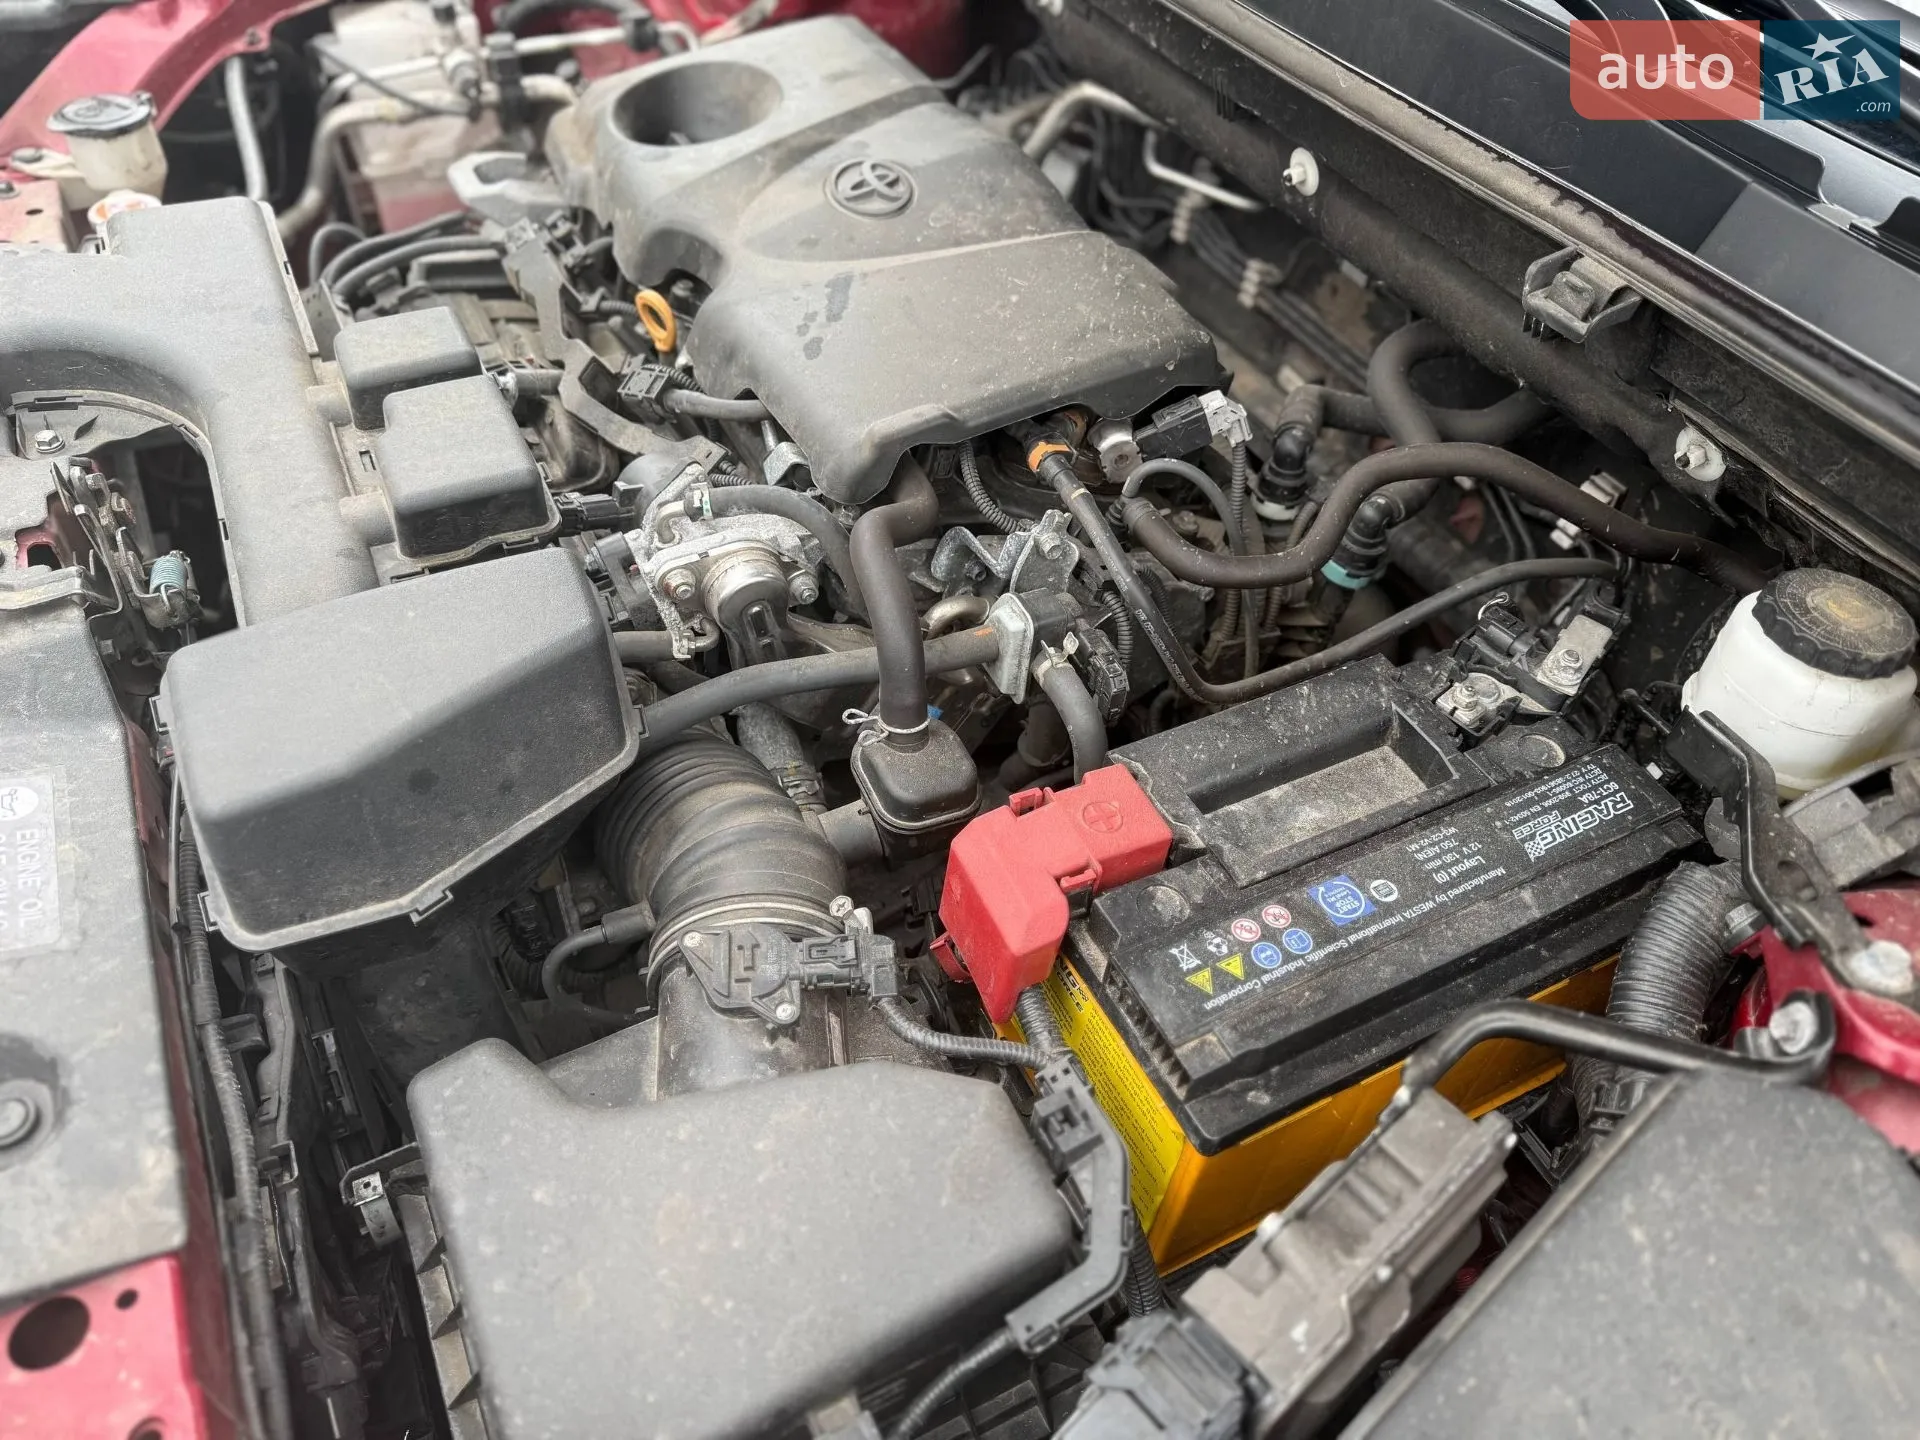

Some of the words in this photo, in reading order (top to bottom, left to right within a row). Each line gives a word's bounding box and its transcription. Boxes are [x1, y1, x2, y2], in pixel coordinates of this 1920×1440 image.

[1512, 810, 1562, 840] FORCE
[1536, 791, 1634, 850] RACING
[1413, 845, 1440, 861] A(EN)
[1439, 838, 1459, 850] 750
[1462, 846, 1472, 855] V
[1469, 841, 1482, 851] 12
[16, 828, 41, 890] ENGINE
[1424, 858, 1442, 870] min
[1442, 851, 1460, 863] 130
[1447, 855, 1486, 878] Layout
[1432, 870, 1450, 884] (0)
[1447, 866, 1507, 899] Manufactured
[1335, 895, 1354, 908] STOP
[1337, 900, 1360, 914] START
[1434, 894, 1449, 904] by
[18, 898, 43, 928] OIL
[1402, 900, 1437, 919] WESTA
[1347, 914, 1405, 945] International
[1304, 939, 1349, 962] Scientific
[1260, 959, 1306, 985] Industrial
[1203, 978, 1262, 1010] Corporation
